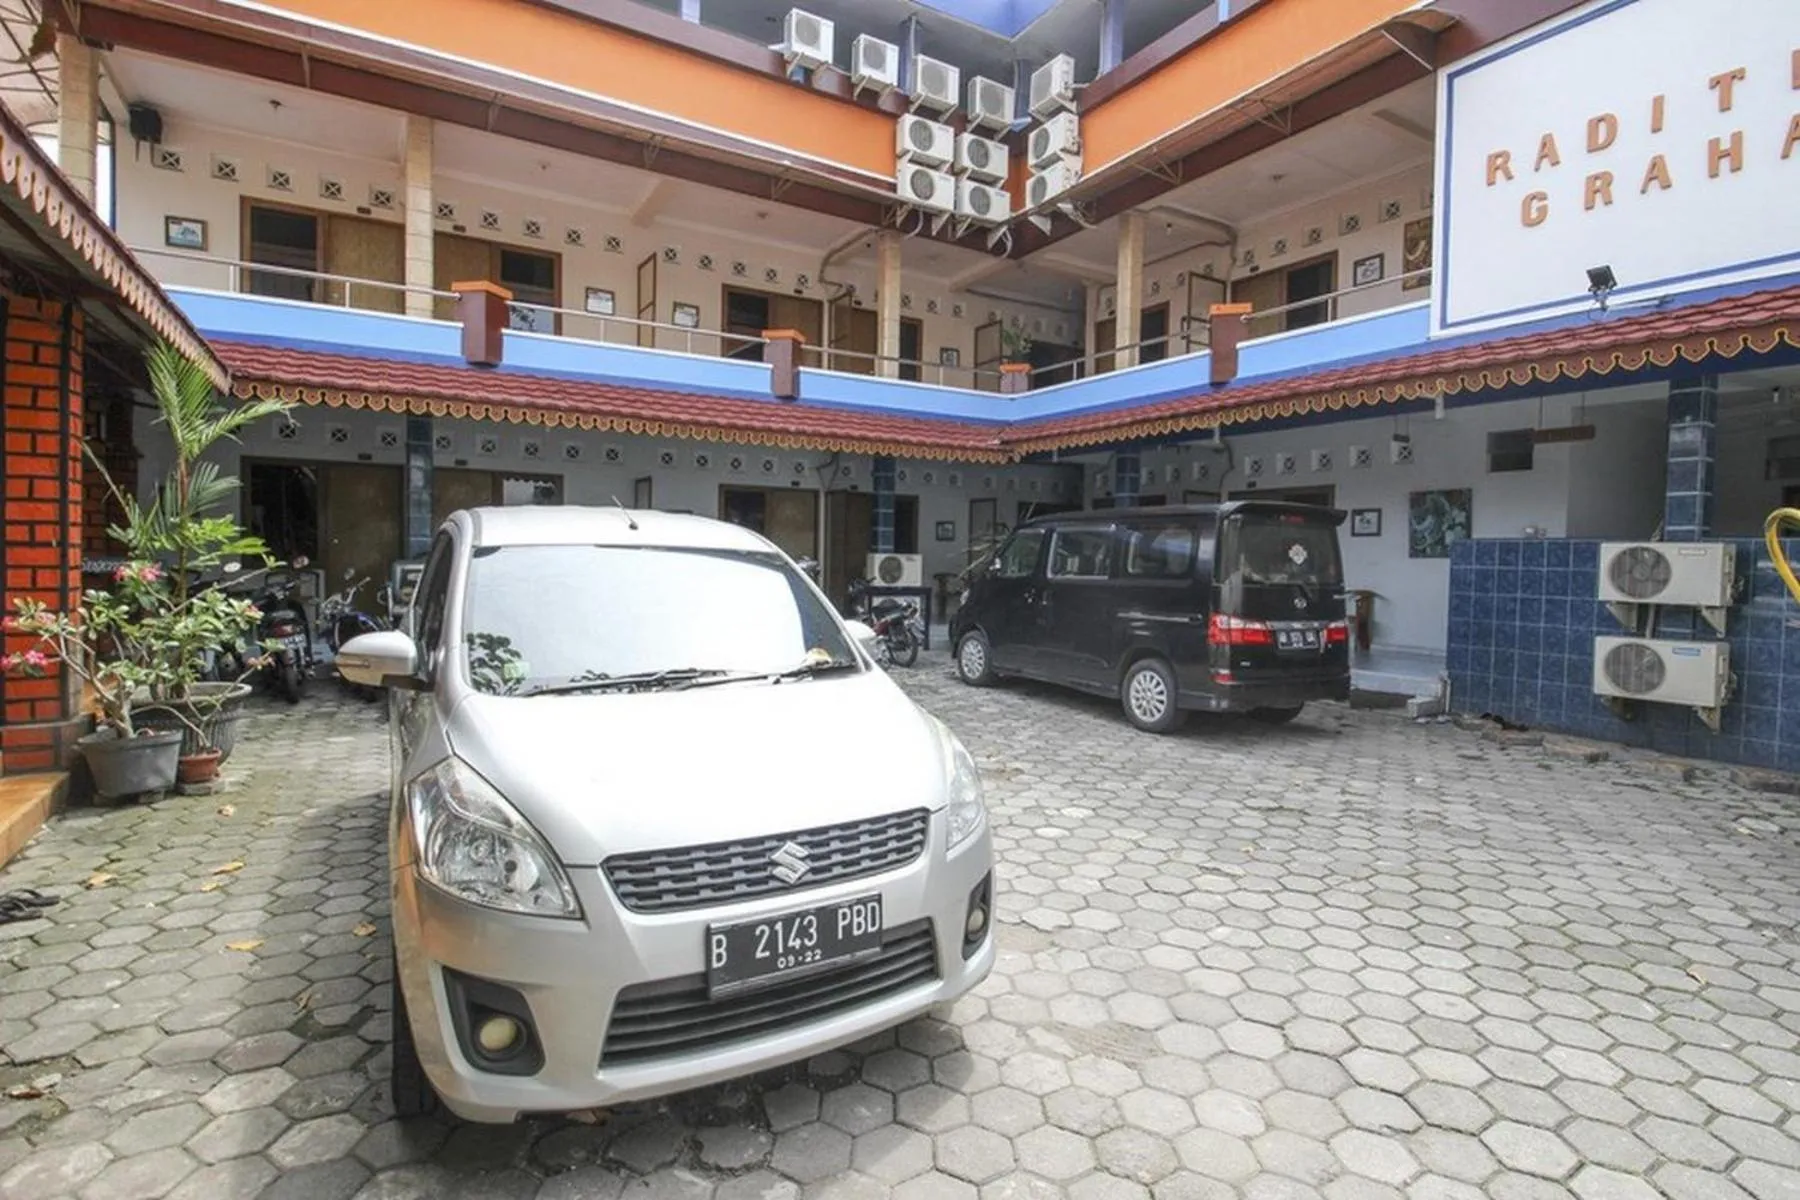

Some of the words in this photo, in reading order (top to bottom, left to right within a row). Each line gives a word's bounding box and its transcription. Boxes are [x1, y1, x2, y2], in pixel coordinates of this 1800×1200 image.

[1521, 113, 1800, 228] GRAHA
[711, 934, 727, 969] B
[755, 915, 818, 959] 2143
[837, 902, 880, 940] PBD
